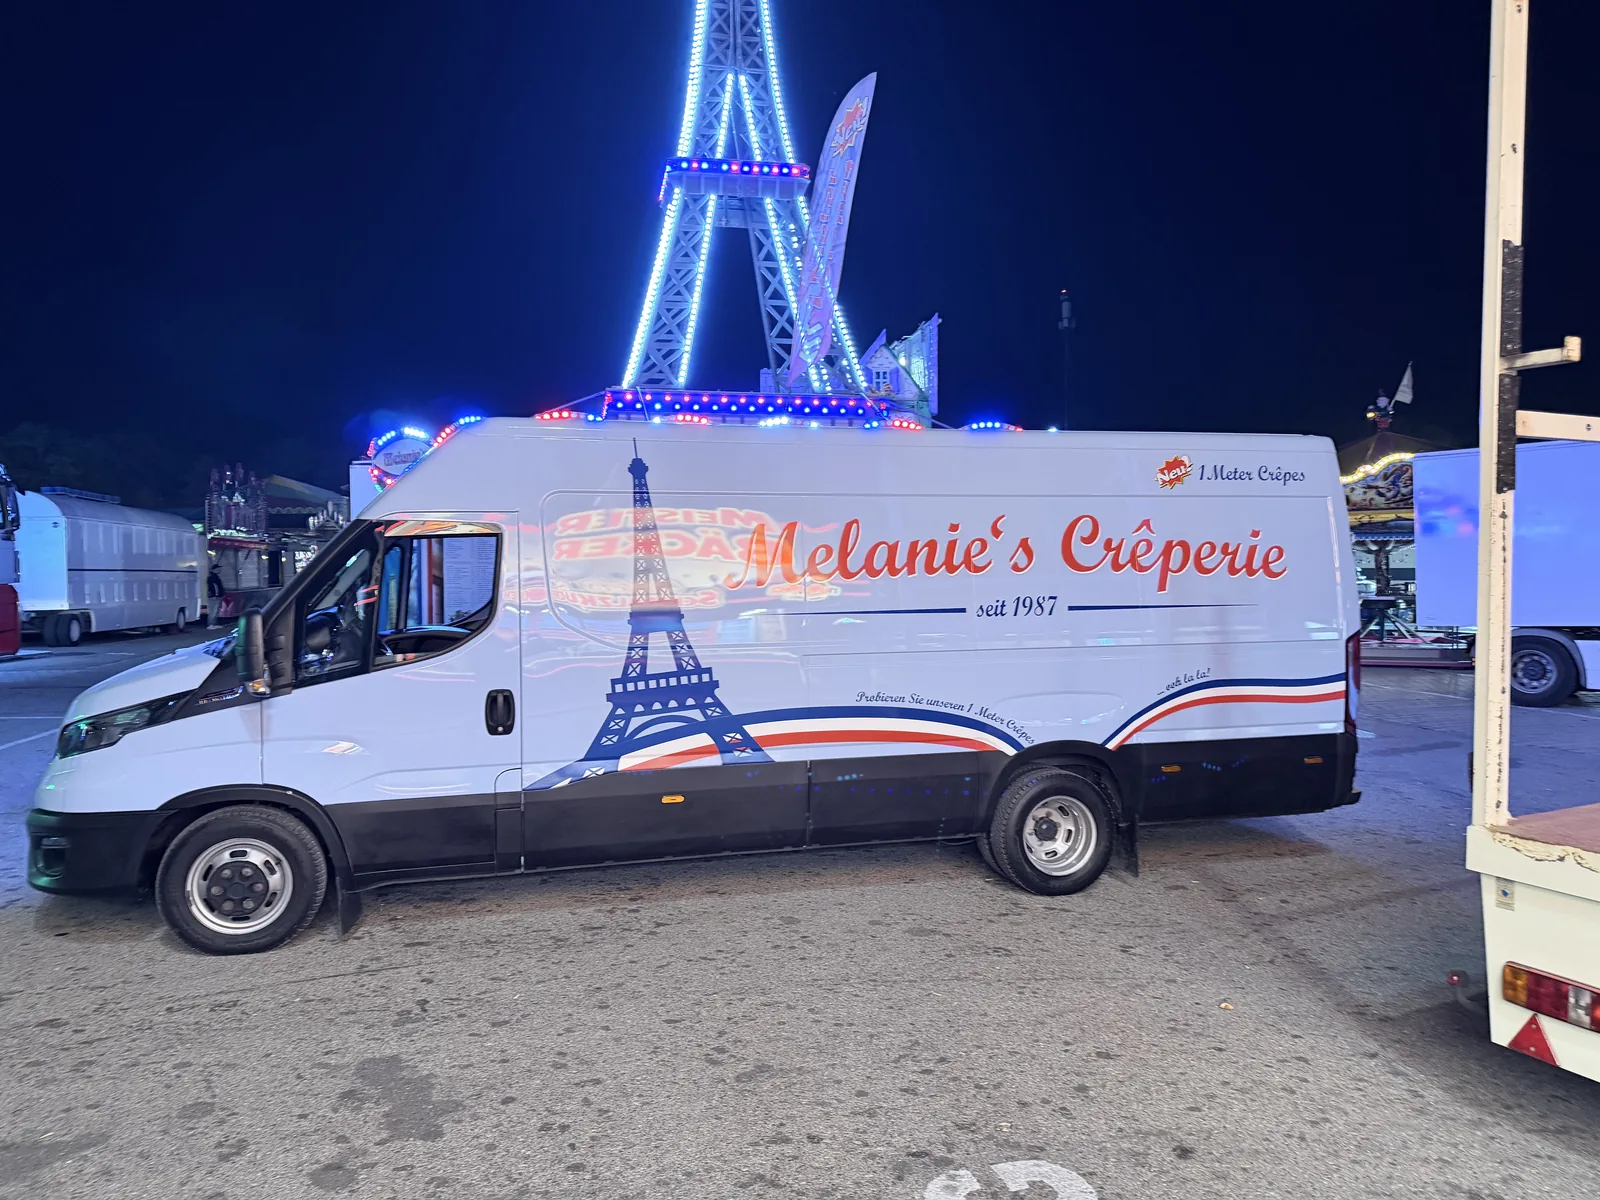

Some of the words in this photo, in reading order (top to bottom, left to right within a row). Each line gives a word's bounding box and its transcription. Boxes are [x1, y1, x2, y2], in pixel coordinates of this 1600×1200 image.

[1155, 454, 1193, 485] Neu!
[1206, 464, 1254, 482] Meter
[1258, 465, 1306, 486] Crêpes
[1061, 514, 1288, 594] Crêperie
[976, 599, 1008, 617] seit
[1012, 595, 1058, 617] 1987
[1183, 673, 1195, 684] la
[855, 691, 906, 703] Probieren
[908, 692, 925, 705] Sie
[926, 698, 965, 712] unseren
[974, 706, 1006, 725] Meter
[1006, 719, 1036, 745] Crêpes
